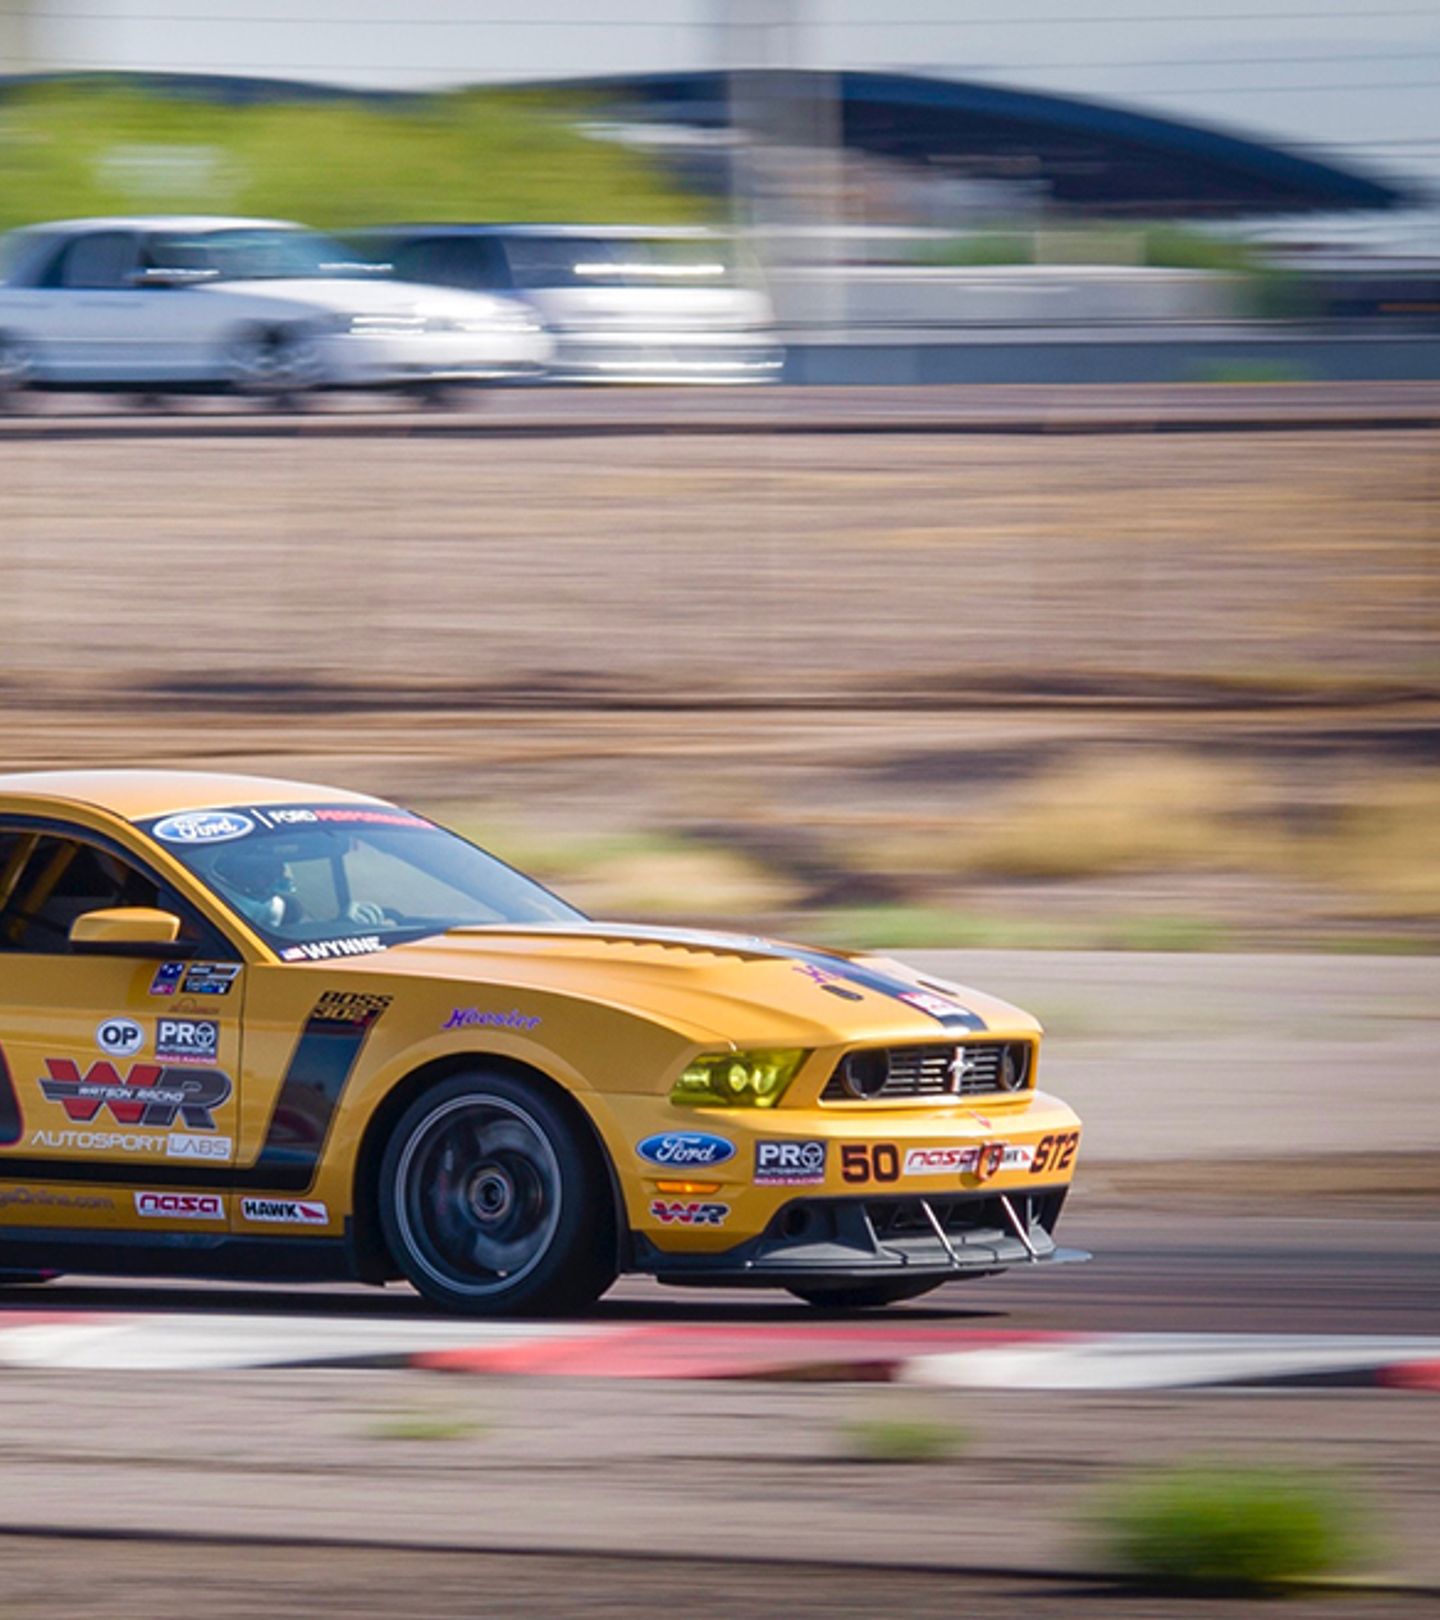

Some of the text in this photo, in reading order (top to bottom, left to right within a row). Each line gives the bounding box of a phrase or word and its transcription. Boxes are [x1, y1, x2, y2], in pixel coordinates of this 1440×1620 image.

[301, 936, 387, 959] WYNNE
[441, 1007, 541, 1030] Hoosier
[102, 1025, 139, 1046] OP
[159, 1021, 215, 1048] PRO
[656, 1137, 717, 1162] Ford
[759, 1143, 824, 1168] PRO
[1029, 1132, 1079, 1173] ST2
[840, 1143, 900, 1183] 50
[244, 1200, 299, 1218] HAWK
